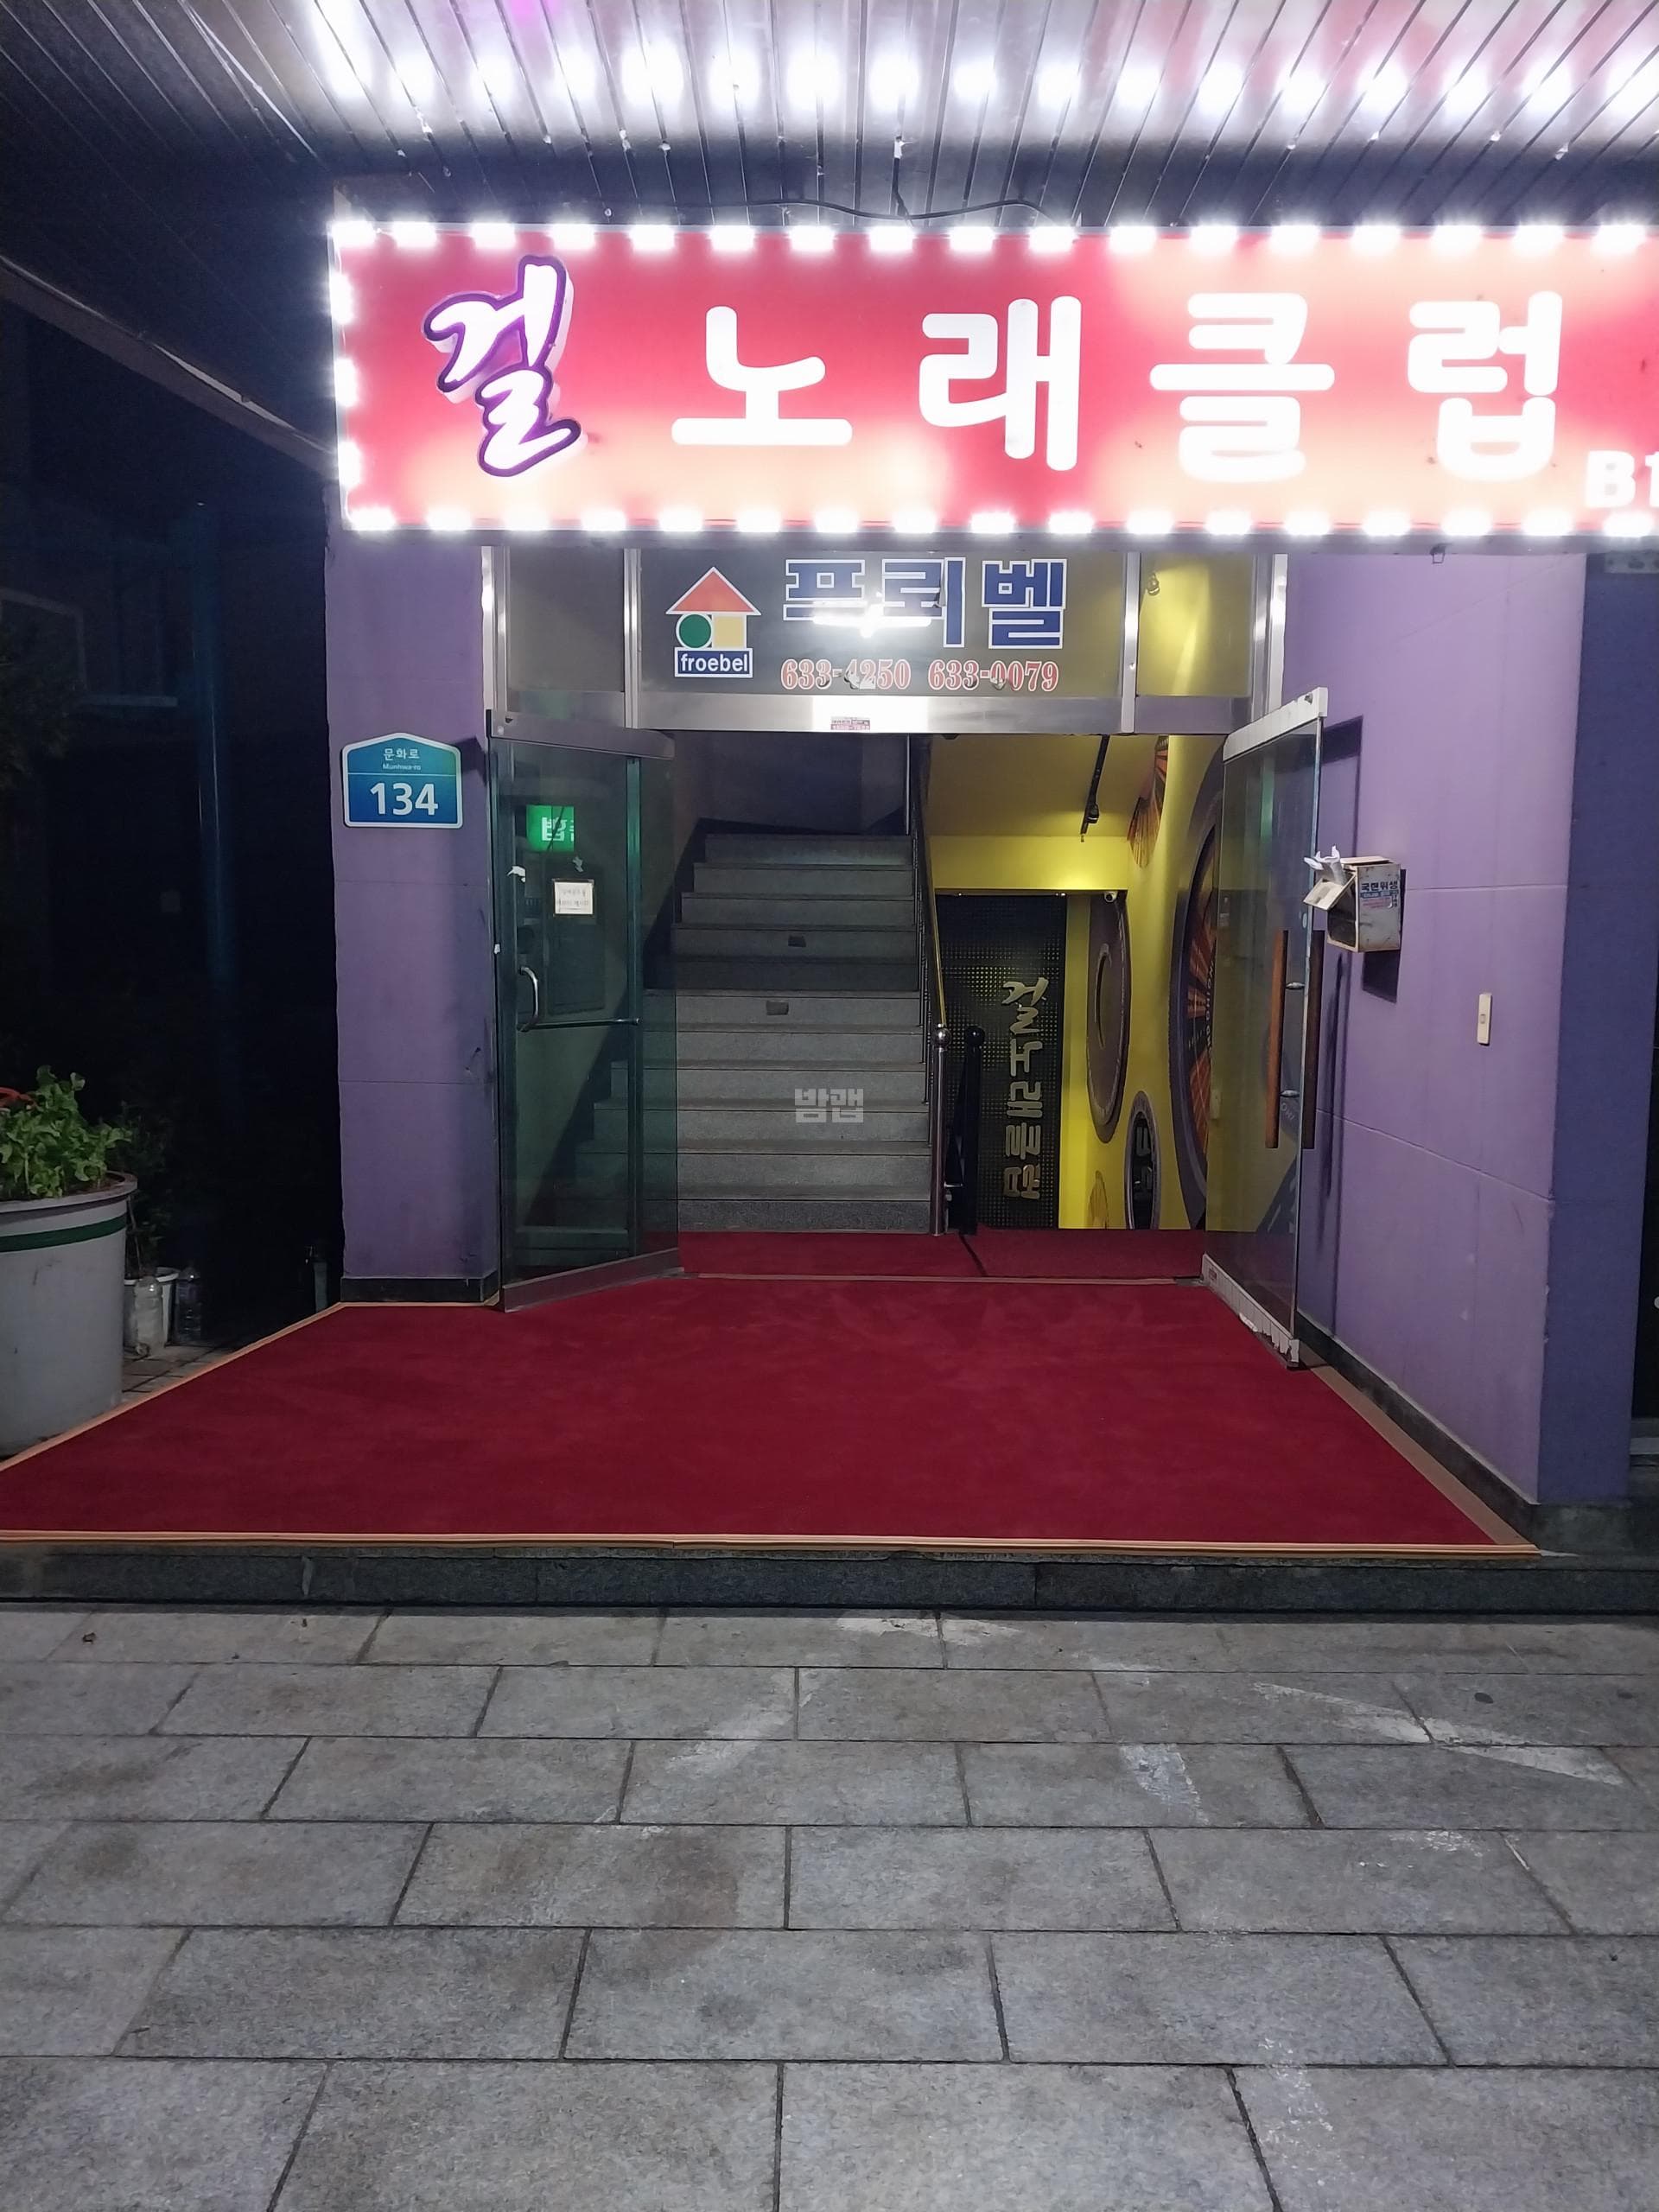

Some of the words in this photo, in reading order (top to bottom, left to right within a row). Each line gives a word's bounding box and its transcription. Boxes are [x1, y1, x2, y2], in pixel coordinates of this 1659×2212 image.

[671, 289, 1563, 483] 노래클럽
[783, 557, 1067, 649] 프뢰벨
[680, 653, 747, 671] froebel
[928, 659, 1059, 691] 633-0079
[383, 748, 420, 760] 문화로
[370, 782, 438, 815] 134
